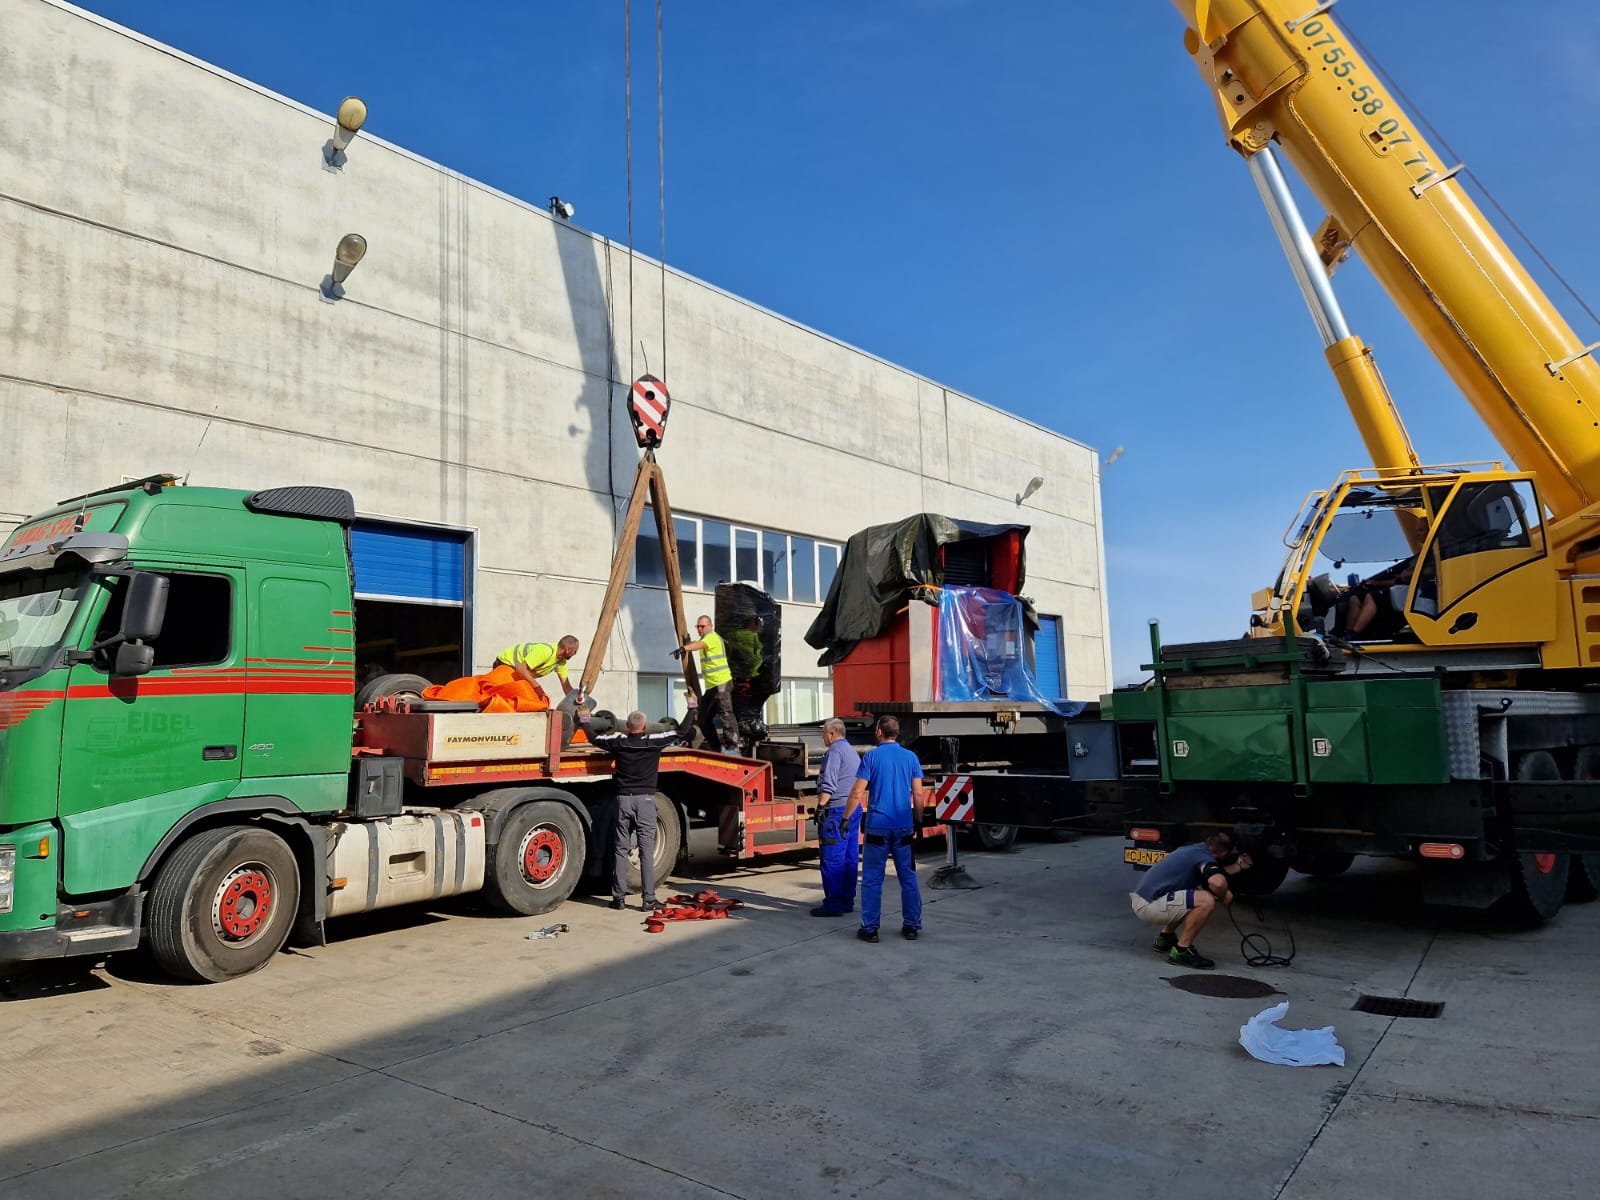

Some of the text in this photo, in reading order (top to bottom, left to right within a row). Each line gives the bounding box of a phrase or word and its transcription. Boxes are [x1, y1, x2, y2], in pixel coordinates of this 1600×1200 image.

[1302, 20, 1437, 183] 0755-58 07 71
[127, 711, 194, 733] EIBEL
[447, 735, 507, 743] FAYMONVILLE
